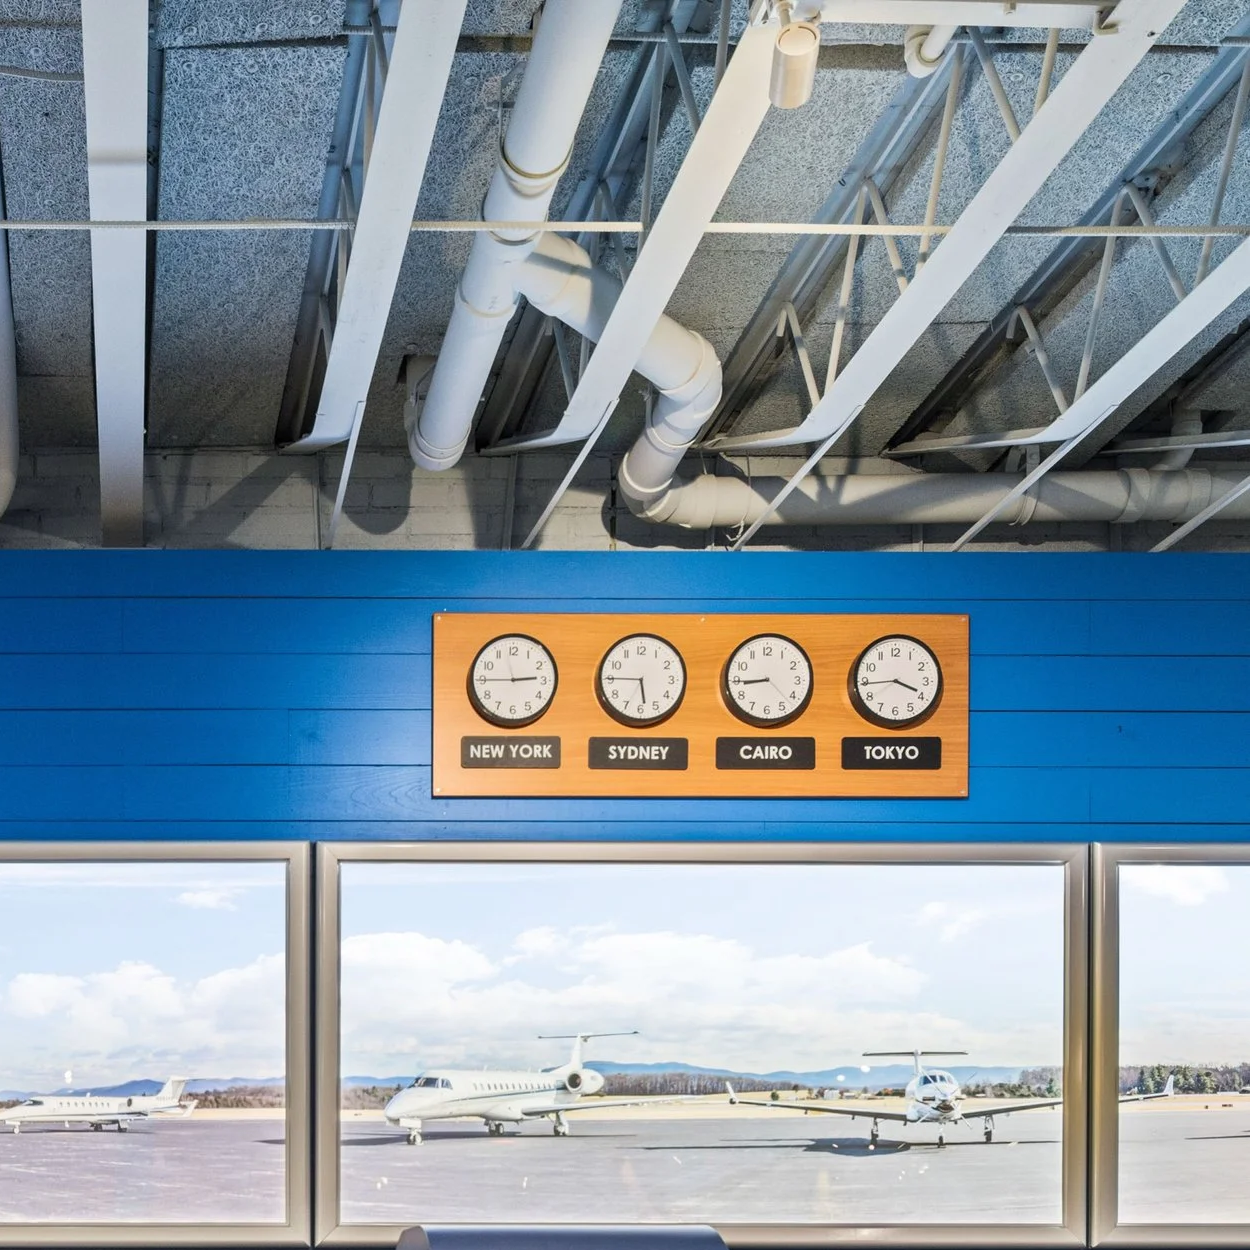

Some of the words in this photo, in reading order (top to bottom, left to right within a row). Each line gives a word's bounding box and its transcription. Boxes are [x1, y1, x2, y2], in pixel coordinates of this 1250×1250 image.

[496, 650, 501, 659] 11
[509, 646, 518, 656] 12
[624, 650, 629, 658] 11
[637, 646, 646, 655] 12
[750, 650, 755, 659] 11
[763, 646, 772, 656] 12
[891, 648, 901, 657] 12
[878, 652, 883, 660] 11
[484, 661, 494, 670] 10
[536, 661, 543, 670] 2
[612, 661, 622, 670] 10
[664, 660, 670, 670] 2
[738, 662, 748, 671] 10
[790, 661, 796, 670] 2
[866, 663, 876, 672] 10
[918, 662, 925, 671] 2
[479, 675, 486, 685] 9
[540, 676, 547, 685] 3
[607, 675, 614, 684] 9
[668, 676, 675, 684] 3
[733, 676, 740, 685] 9
[794, 676, 801, 685] 3
[862, 677, 868, 686] 9
[922, 677, 929, 686] 3
[484, 690, 491, 700] 8
[535, 691, 542, 699] 4
[612, 689, 619, 699] 8
[663, 690, 670, 699] 4
[738, 691, 745, 700] 8
[789, 691, 796, 700] 4
[866, 692, 873, 701] 8
[918, 692, 924, 701] 4
[495, 701, 501, 710] 7
[510, 705, 516, 714] 6
[524, 701, 531, 711] 5
[623, 701, 629, 710] 7
[637, 705, 644, 714] 6
[652, 701, 659, 710] 5
[749, 702, 755, 711] 7
[764, 705, 770, 715] 6
[778, 702, 786, 711] 5
[878, 703, 884, 712] 7
[907, 703, 914, 712] 5
[892, 707, 899, 716] 6
[470, 744, 504, 758] NEW
[510, 744, 552, 758] YORK
[608, 746, 669, 760] SYDNEY
[740, 745, 792, 760] CAIRO
[864, 746, 919, 760] TOKYO
